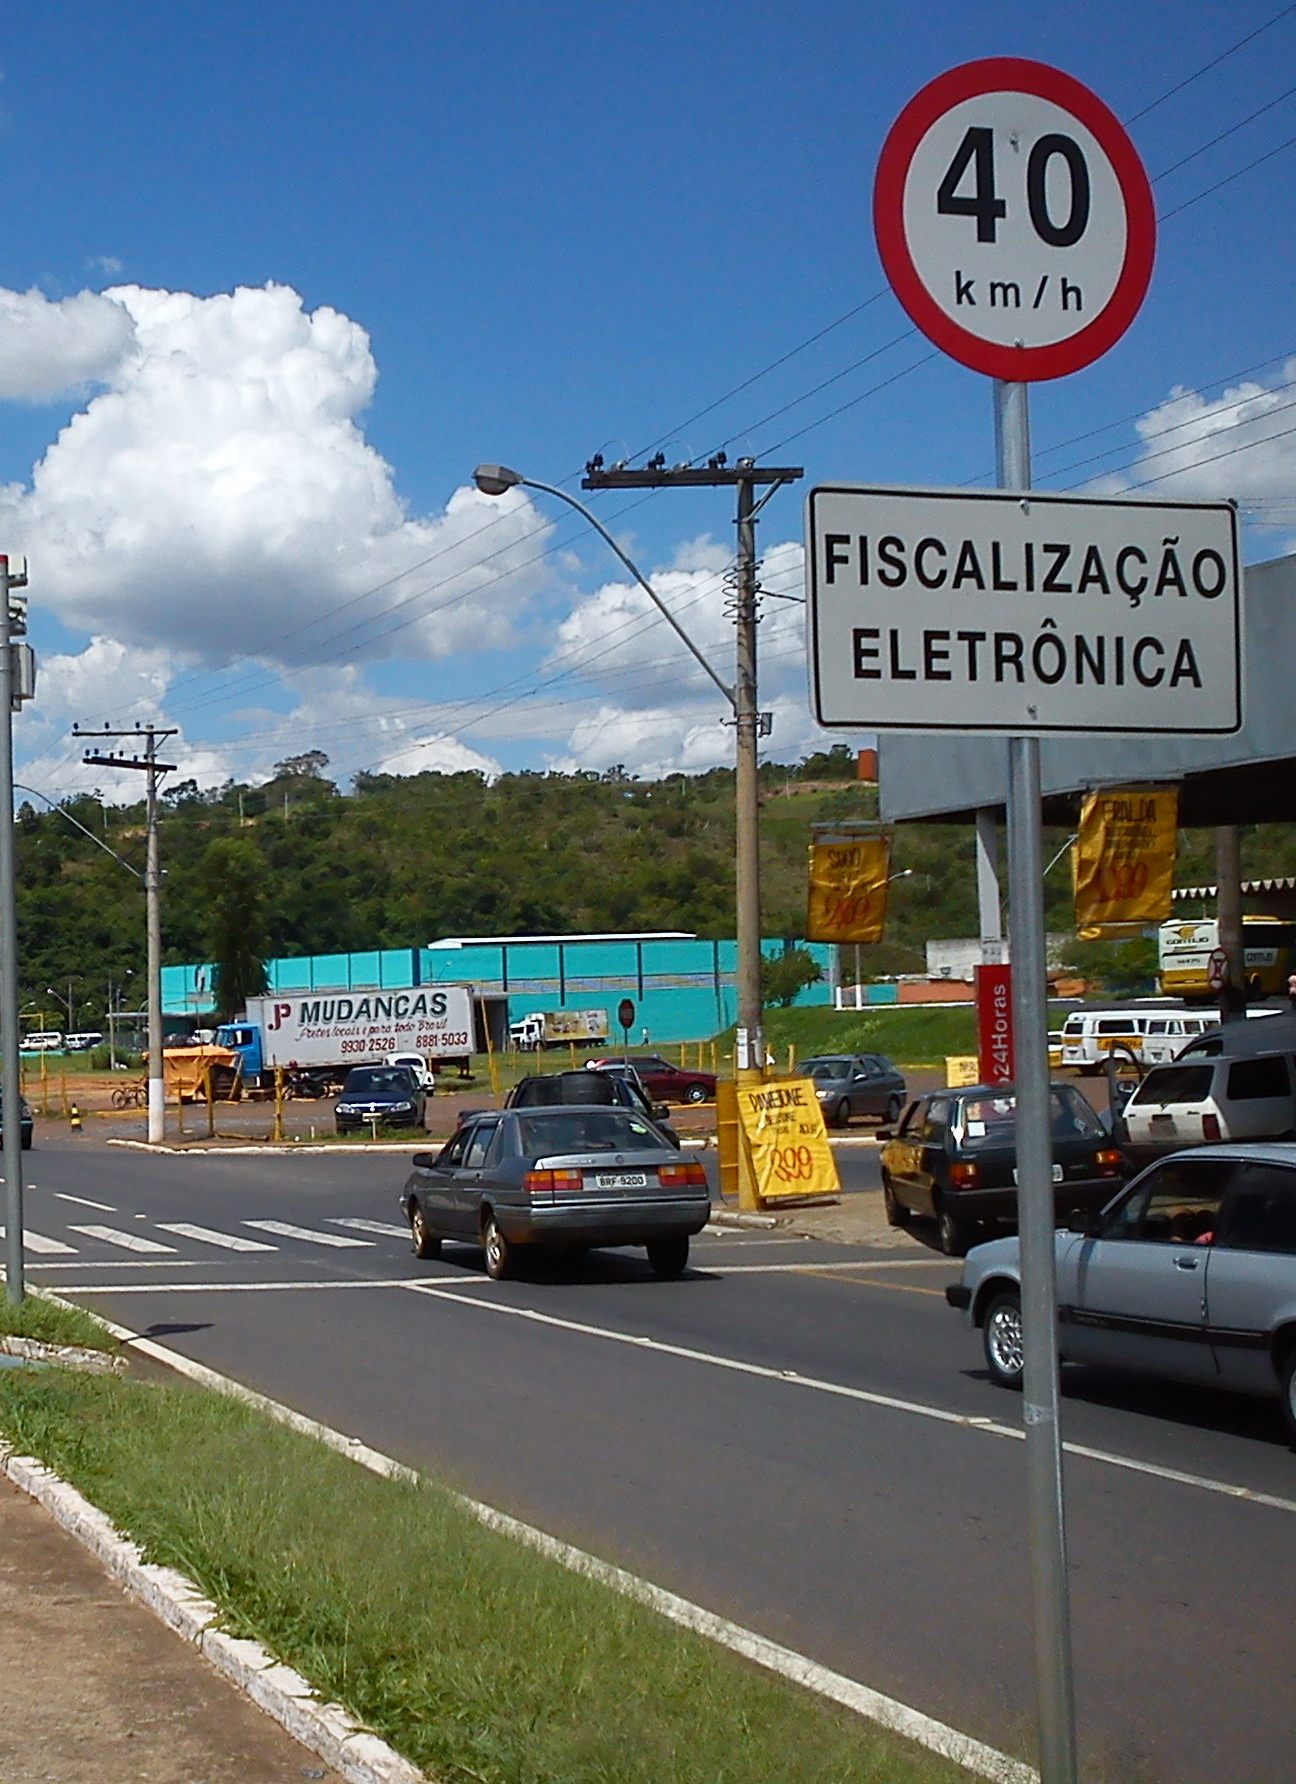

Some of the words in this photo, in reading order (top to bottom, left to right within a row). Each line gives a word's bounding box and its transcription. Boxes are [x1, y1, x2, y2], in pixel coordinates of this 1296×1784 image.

[937, 126, 1091, 248] 40
[955, 270, 1083, 312] km/h
[824, 534, 1227, 608] FISCALIZAÇÃO
[851, 617, 1203, 689] ELETRÔNICA
